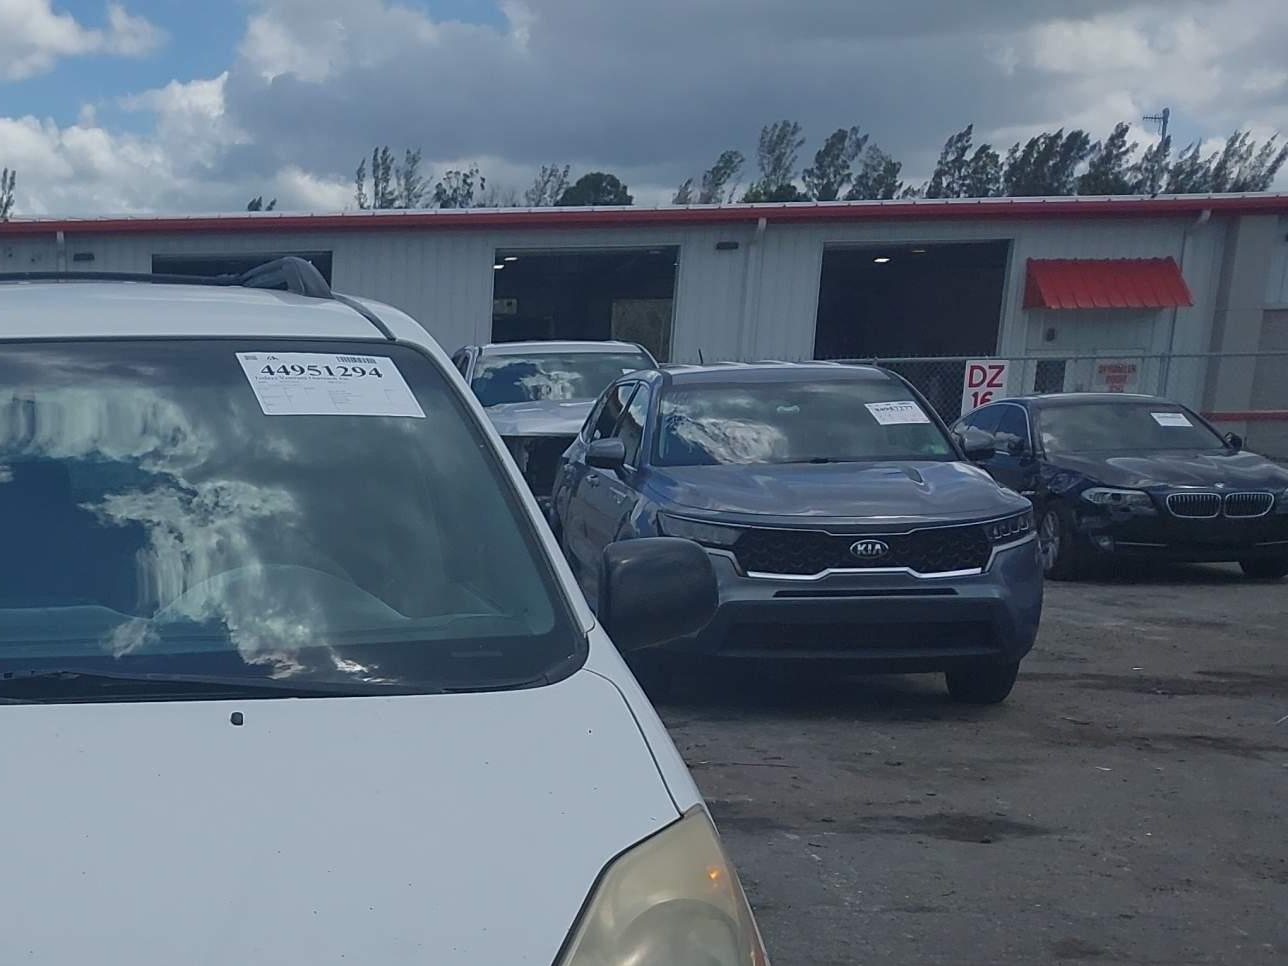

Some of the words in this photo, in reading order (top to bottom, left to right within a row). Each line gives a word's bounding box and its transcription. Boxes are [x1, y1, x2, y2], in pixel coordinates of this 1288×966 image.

[260, 364, 383, 378] 44951294
[968, 365, 1005, 388] DZ
[857, 543, 882, 555] KIA
